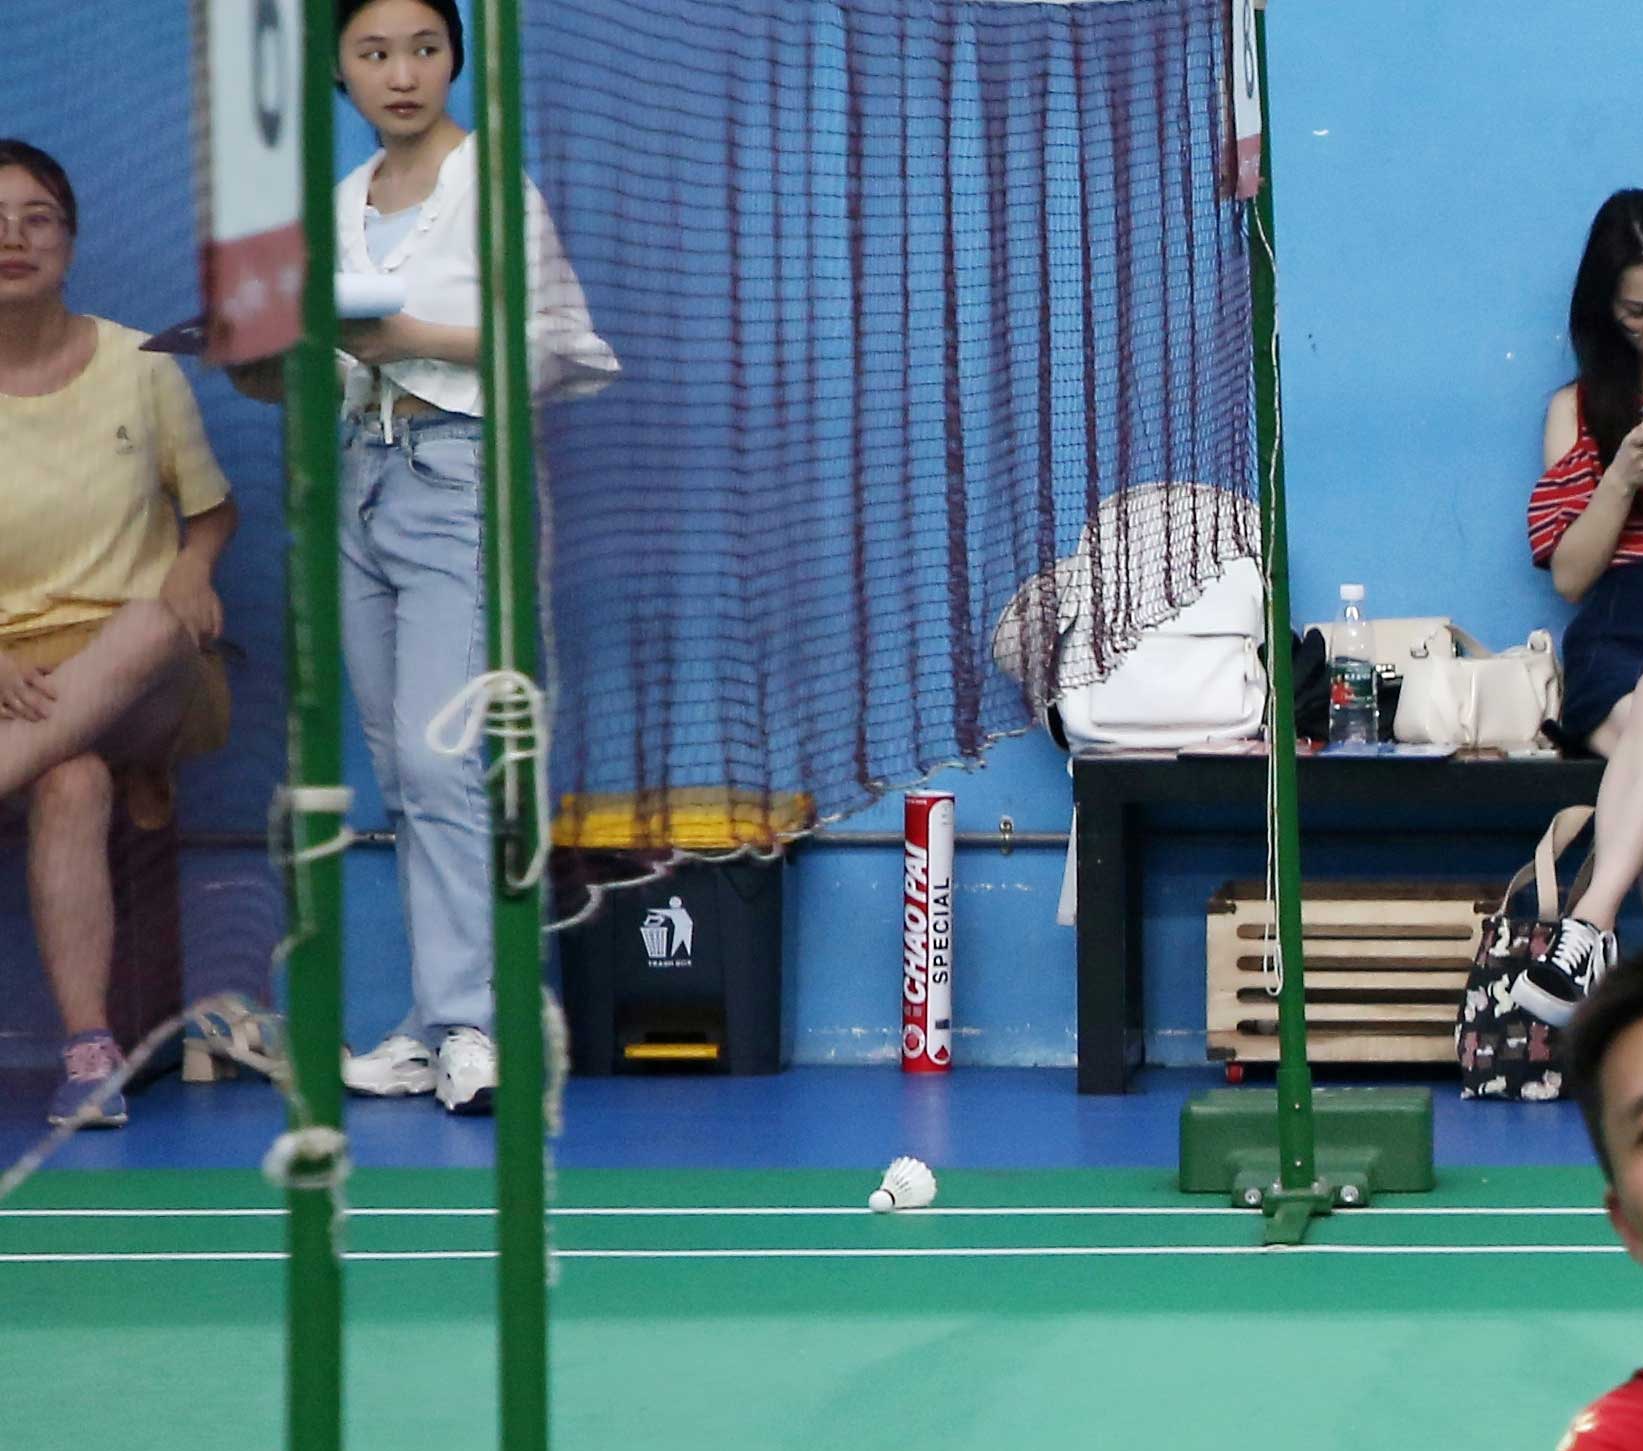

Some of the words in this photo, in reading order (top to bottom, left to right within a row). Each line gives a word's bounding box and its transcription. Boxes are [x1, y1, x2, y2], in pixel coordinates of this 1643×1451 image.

[905, 841, 928, 903] PAI
[903, 909, 928, 1004] CHAO
[932, 878, 951, 984] SPECIAL
